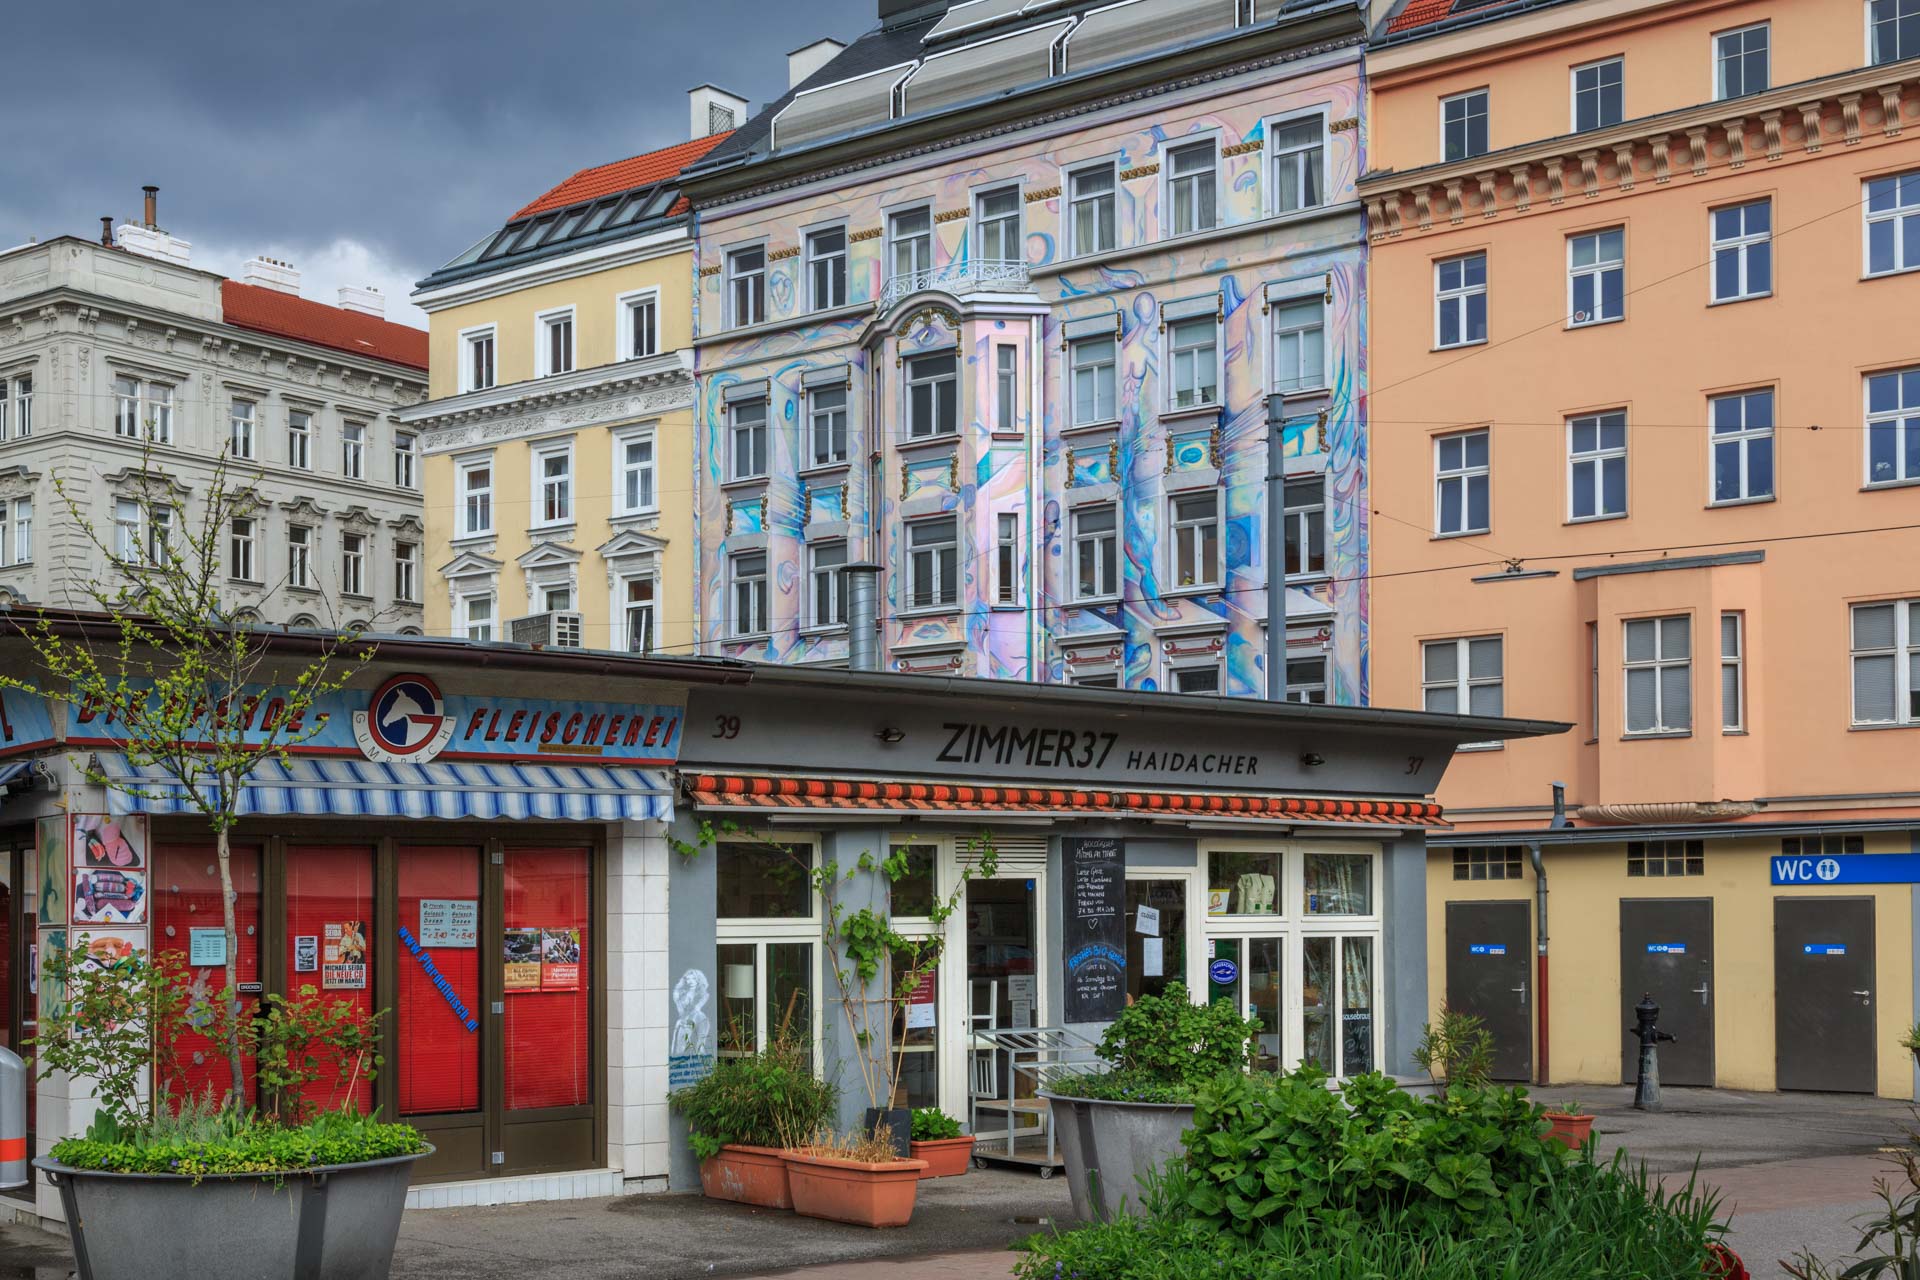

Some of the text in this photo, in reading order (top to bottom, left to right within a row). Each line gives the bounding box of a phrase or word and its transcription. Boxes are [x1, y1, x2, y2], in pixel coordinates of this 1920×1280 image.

[464, 708, 678, 747] FLEISCHEREI
[712, 714, 741, 739] 39
[936, 723, 1258, 775] ZIMMER37 HAIDACHER
[1404, 756, 1424, 775] 37
[1776, 859, 1813, 881] WC
[325, 971, 334, 979] DIE
